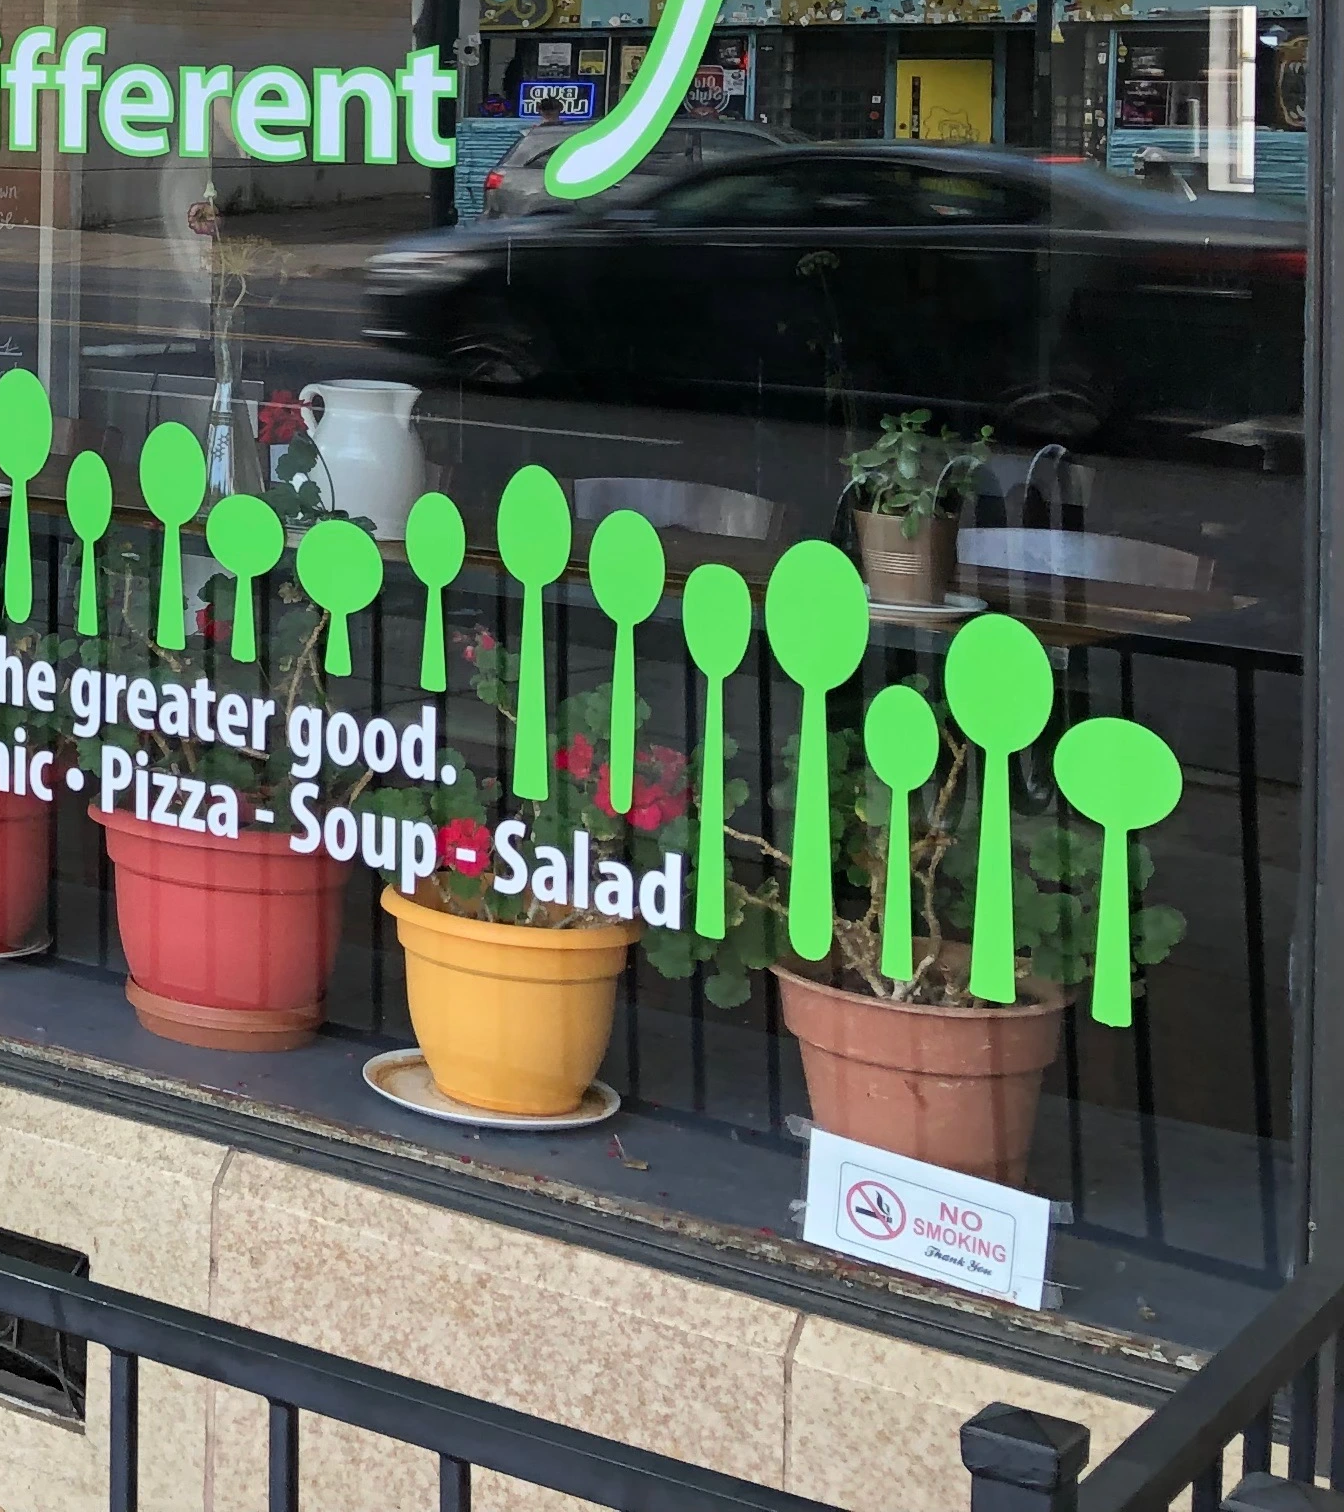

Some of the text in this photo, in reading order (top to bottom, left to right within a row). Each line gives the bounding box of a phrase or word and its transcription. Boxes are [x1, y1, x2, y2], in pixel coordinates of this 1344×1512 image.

[70, 667, 276, 752] greater
[286, 704, 458, 787] good.
[100, 745, 240, 839] Pizza
[289, 782, 437, 895] Soup
[494, 821, 684, 932] Salad
[912, 1217, 1007, 1264] SMOKING
[939, 1201, 983, 1233] NO
[924, 1245, 993, 1276] Thank You
